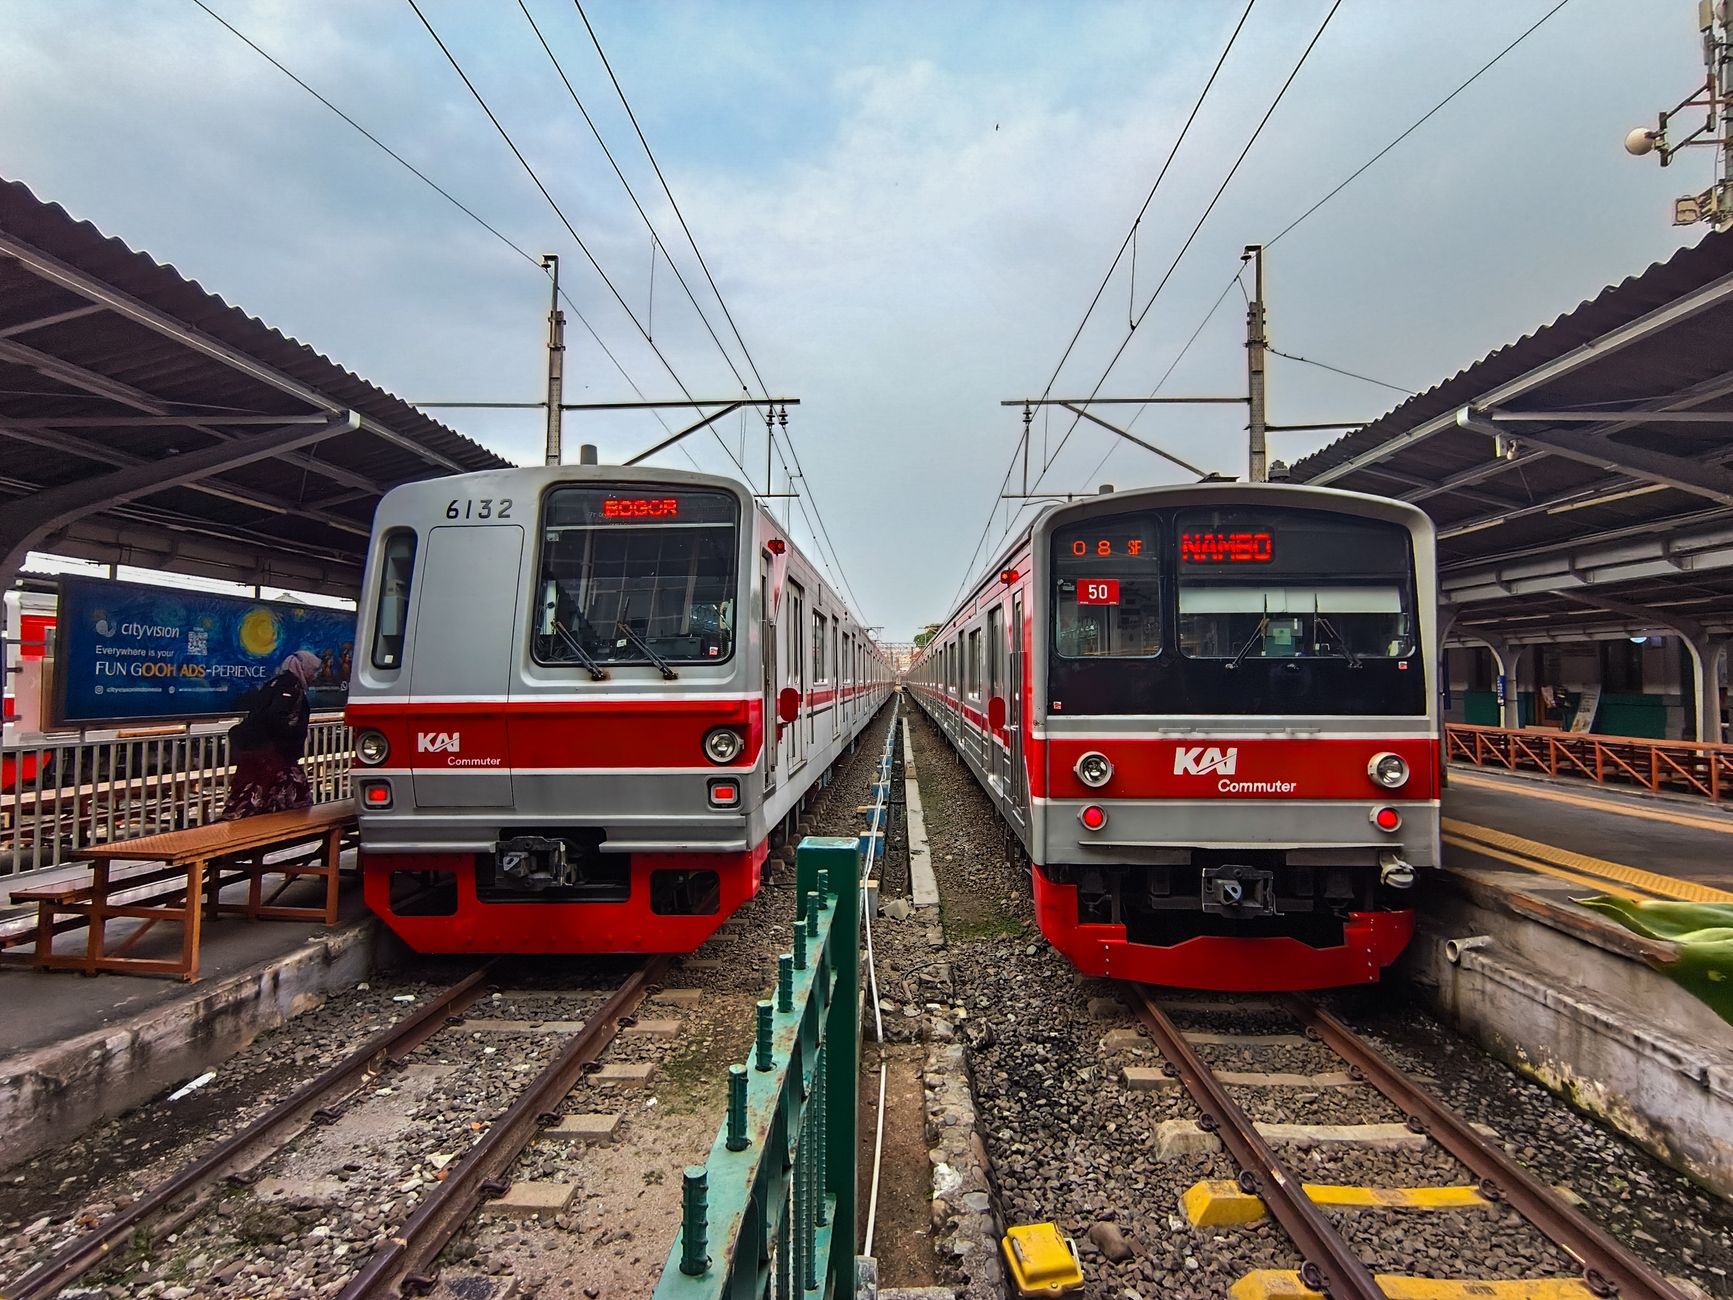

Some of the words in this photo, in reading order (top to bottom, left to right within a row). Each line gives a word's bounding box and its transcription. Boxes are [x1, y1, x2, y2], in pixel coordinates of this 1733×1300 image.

[446, 499, 513, 520] 6132
[1182, 533, 1272, 561] NAMBO
[1088, 584, 1108, 600] 50
[121, 622, 180, 639] cityvision
[95, 645, 146, 658] Everywhere
[148, 648, 155, 657] is
[157, 649, 174, 659] your
[95, 661, 127, 676] FUN
[130, 662, 176, 677] GOOH
[417, 732, 460, 753] KAI
[447, 756, 501, 766] Commuter
[1173, 747, 1238, 775] KAI
[1217, 778, 1297, 793] Commuter
